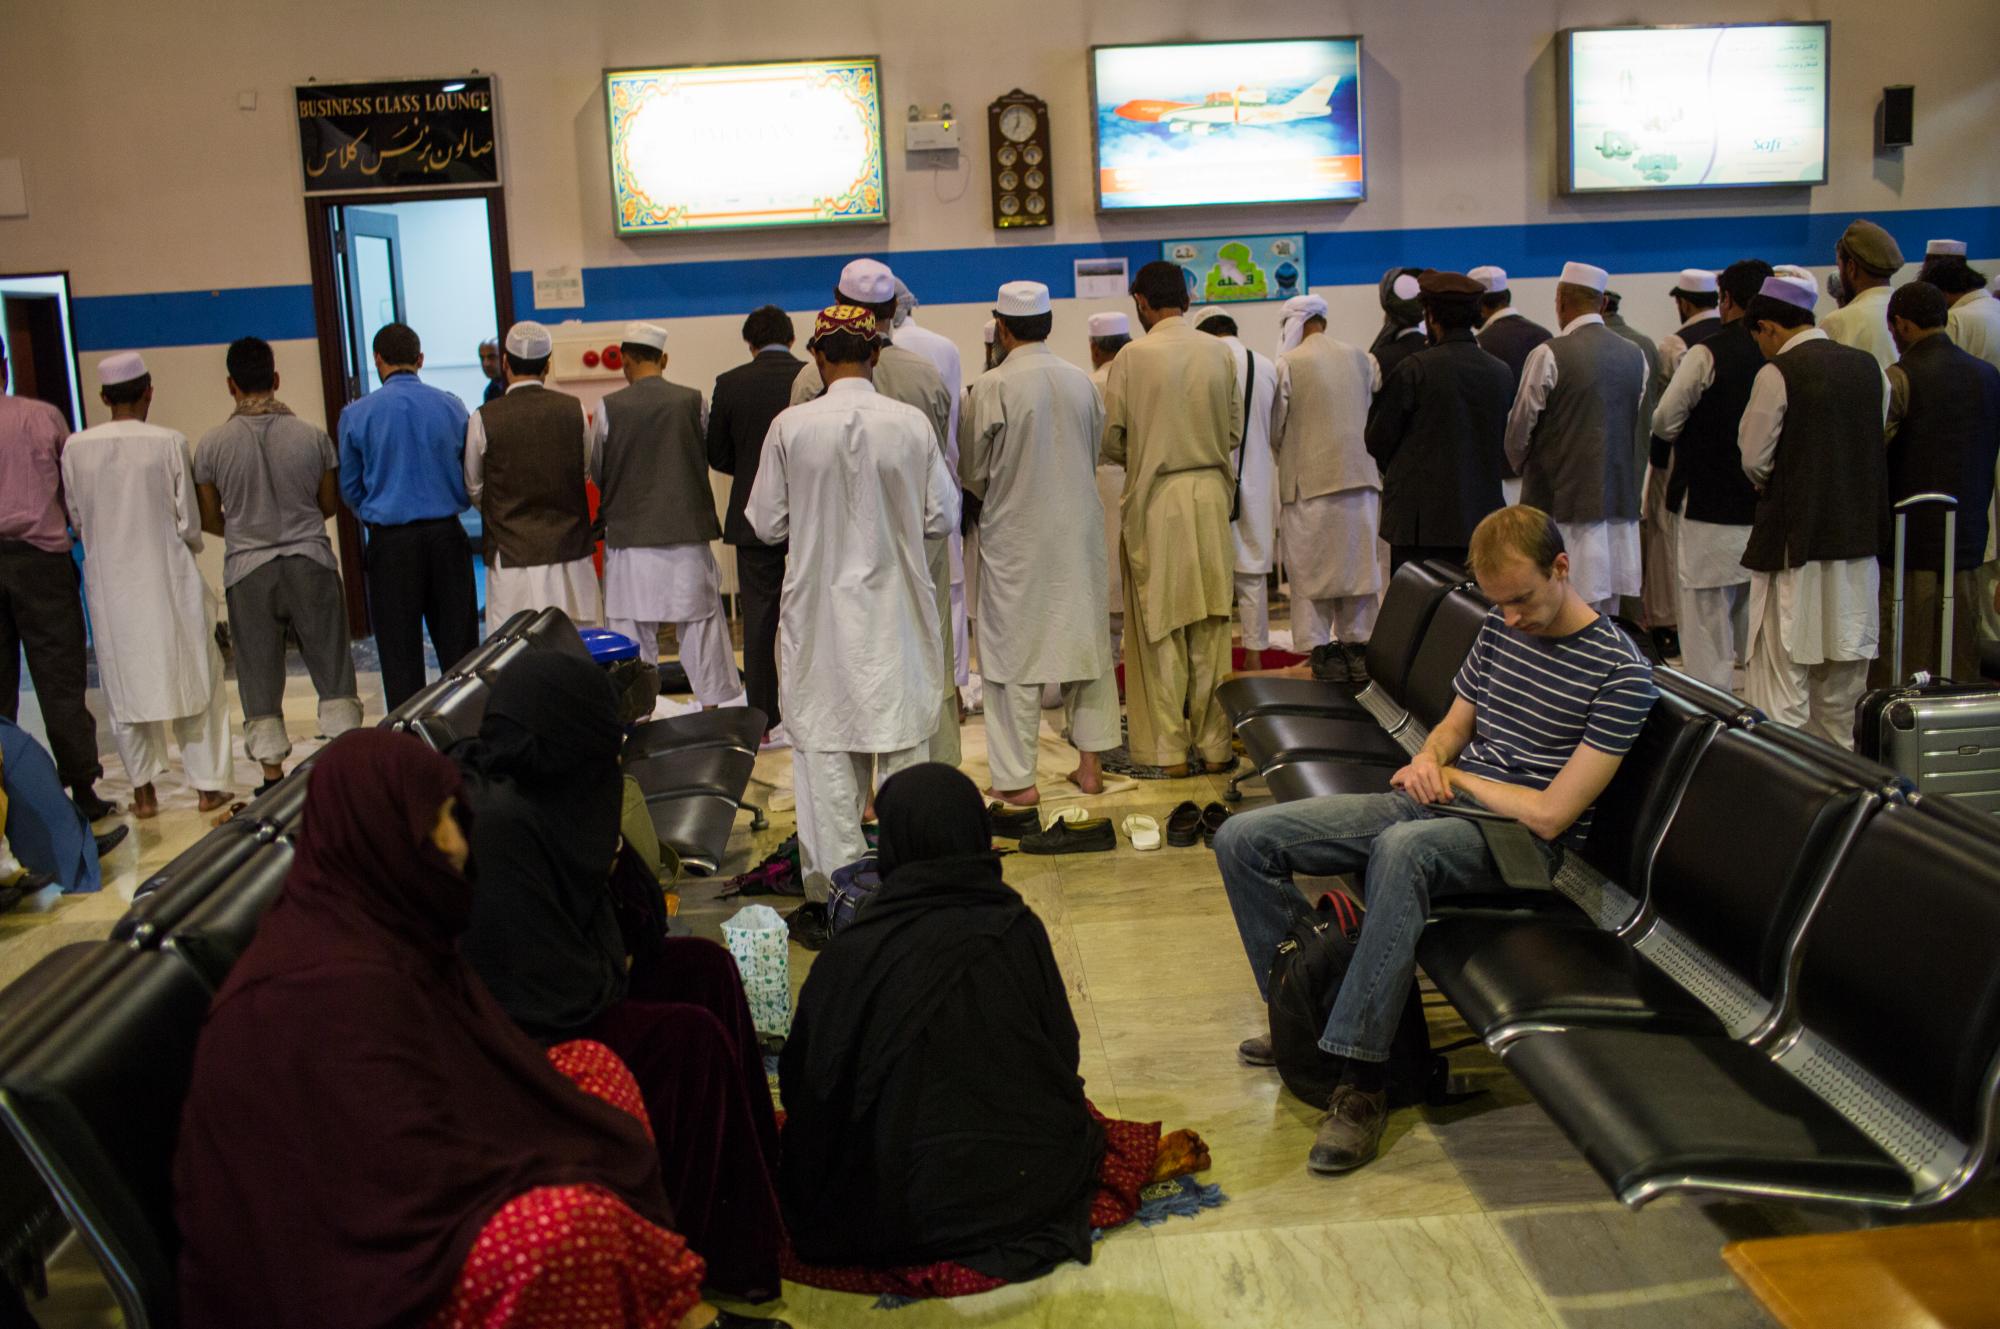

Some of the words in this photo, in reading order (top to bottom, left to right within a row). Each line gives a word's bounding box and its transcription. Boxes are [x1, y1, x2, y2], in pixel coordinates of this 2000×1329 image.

[299, 97, 372, 118] BUSINESS
[376, 94, 420, 113] CLASS
[425, 90, 490, 112] LOUNGE
[429, 128, 493, 170] صالون
